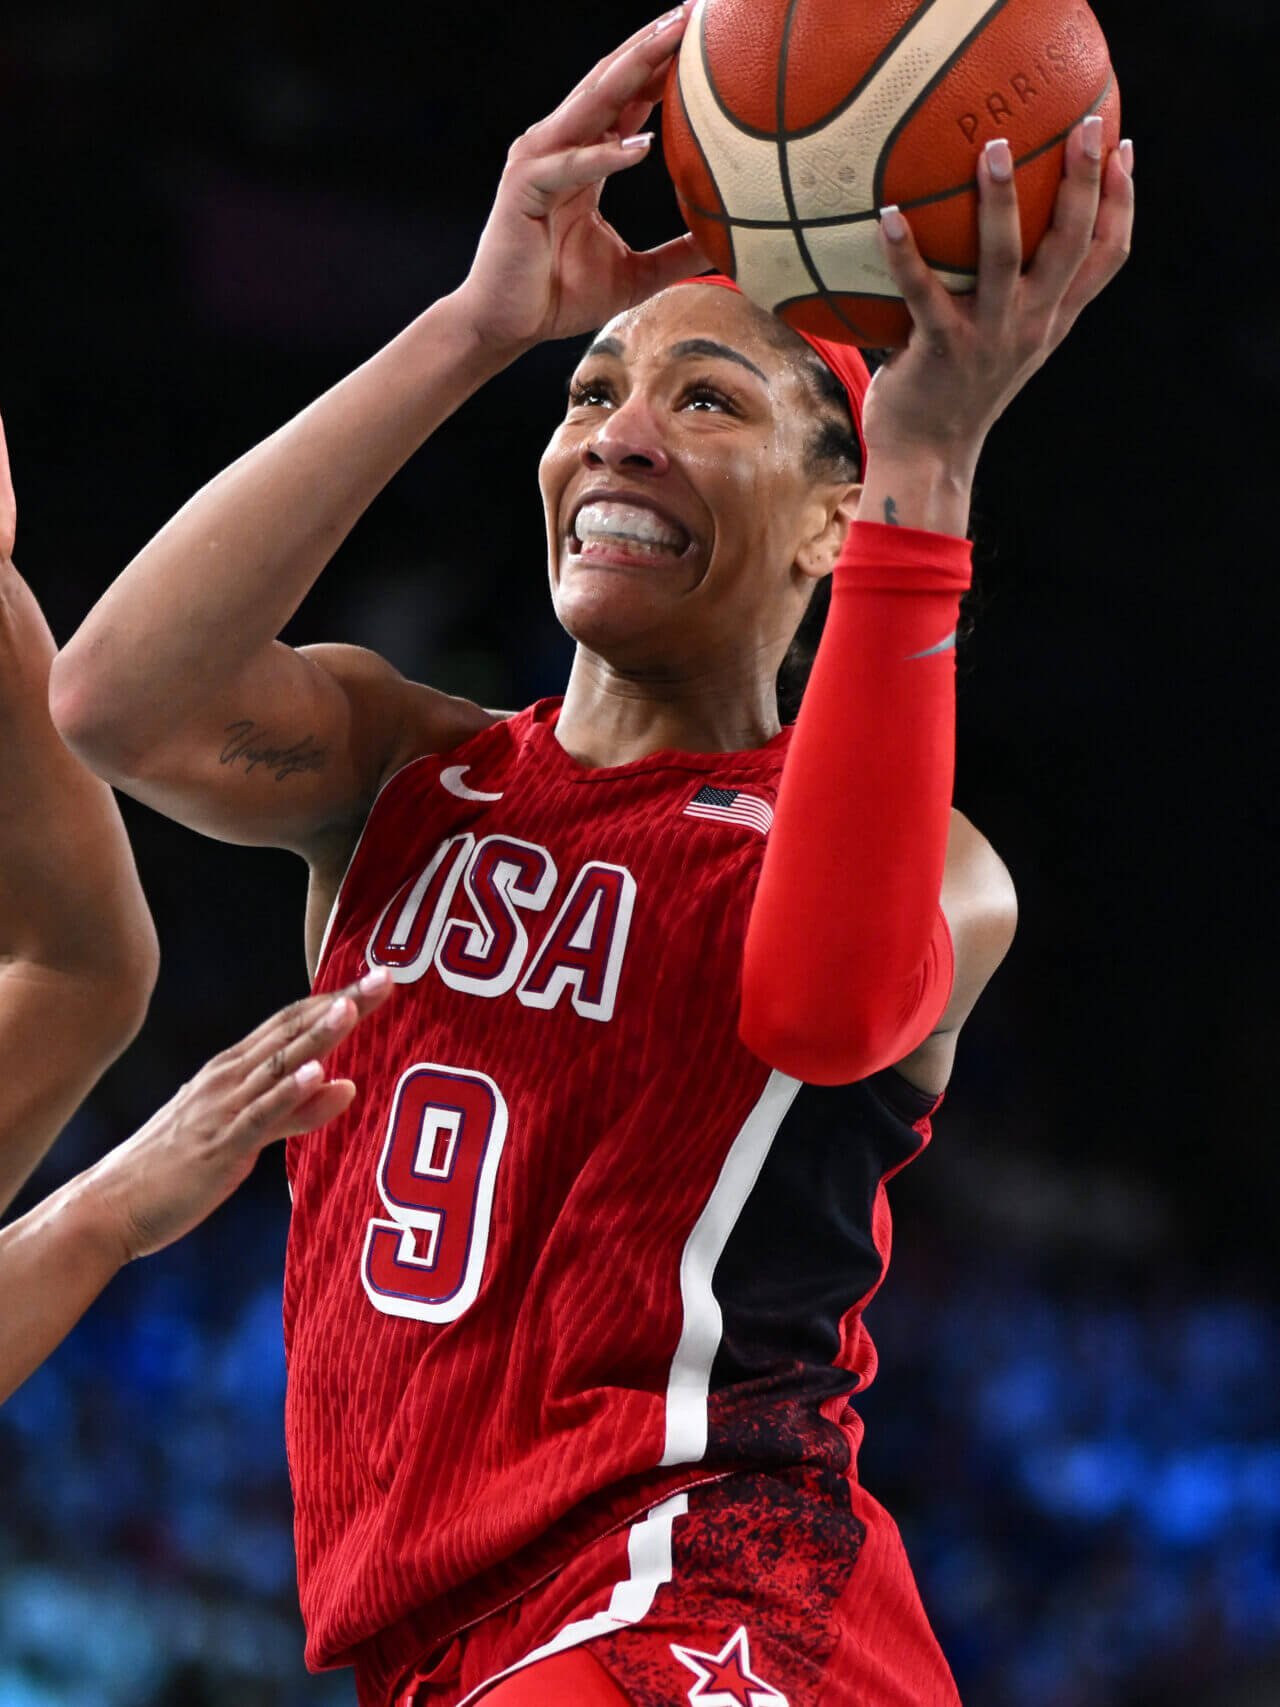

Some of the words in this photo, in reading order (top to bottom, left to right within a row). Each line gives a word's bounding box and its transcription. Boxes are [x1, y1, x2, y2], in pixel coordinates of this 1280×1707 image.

[957, 44, 1068, 145] PARIS
[365, 832, 638, 1022] USA
[361, 1062, 508, 1324] 9
